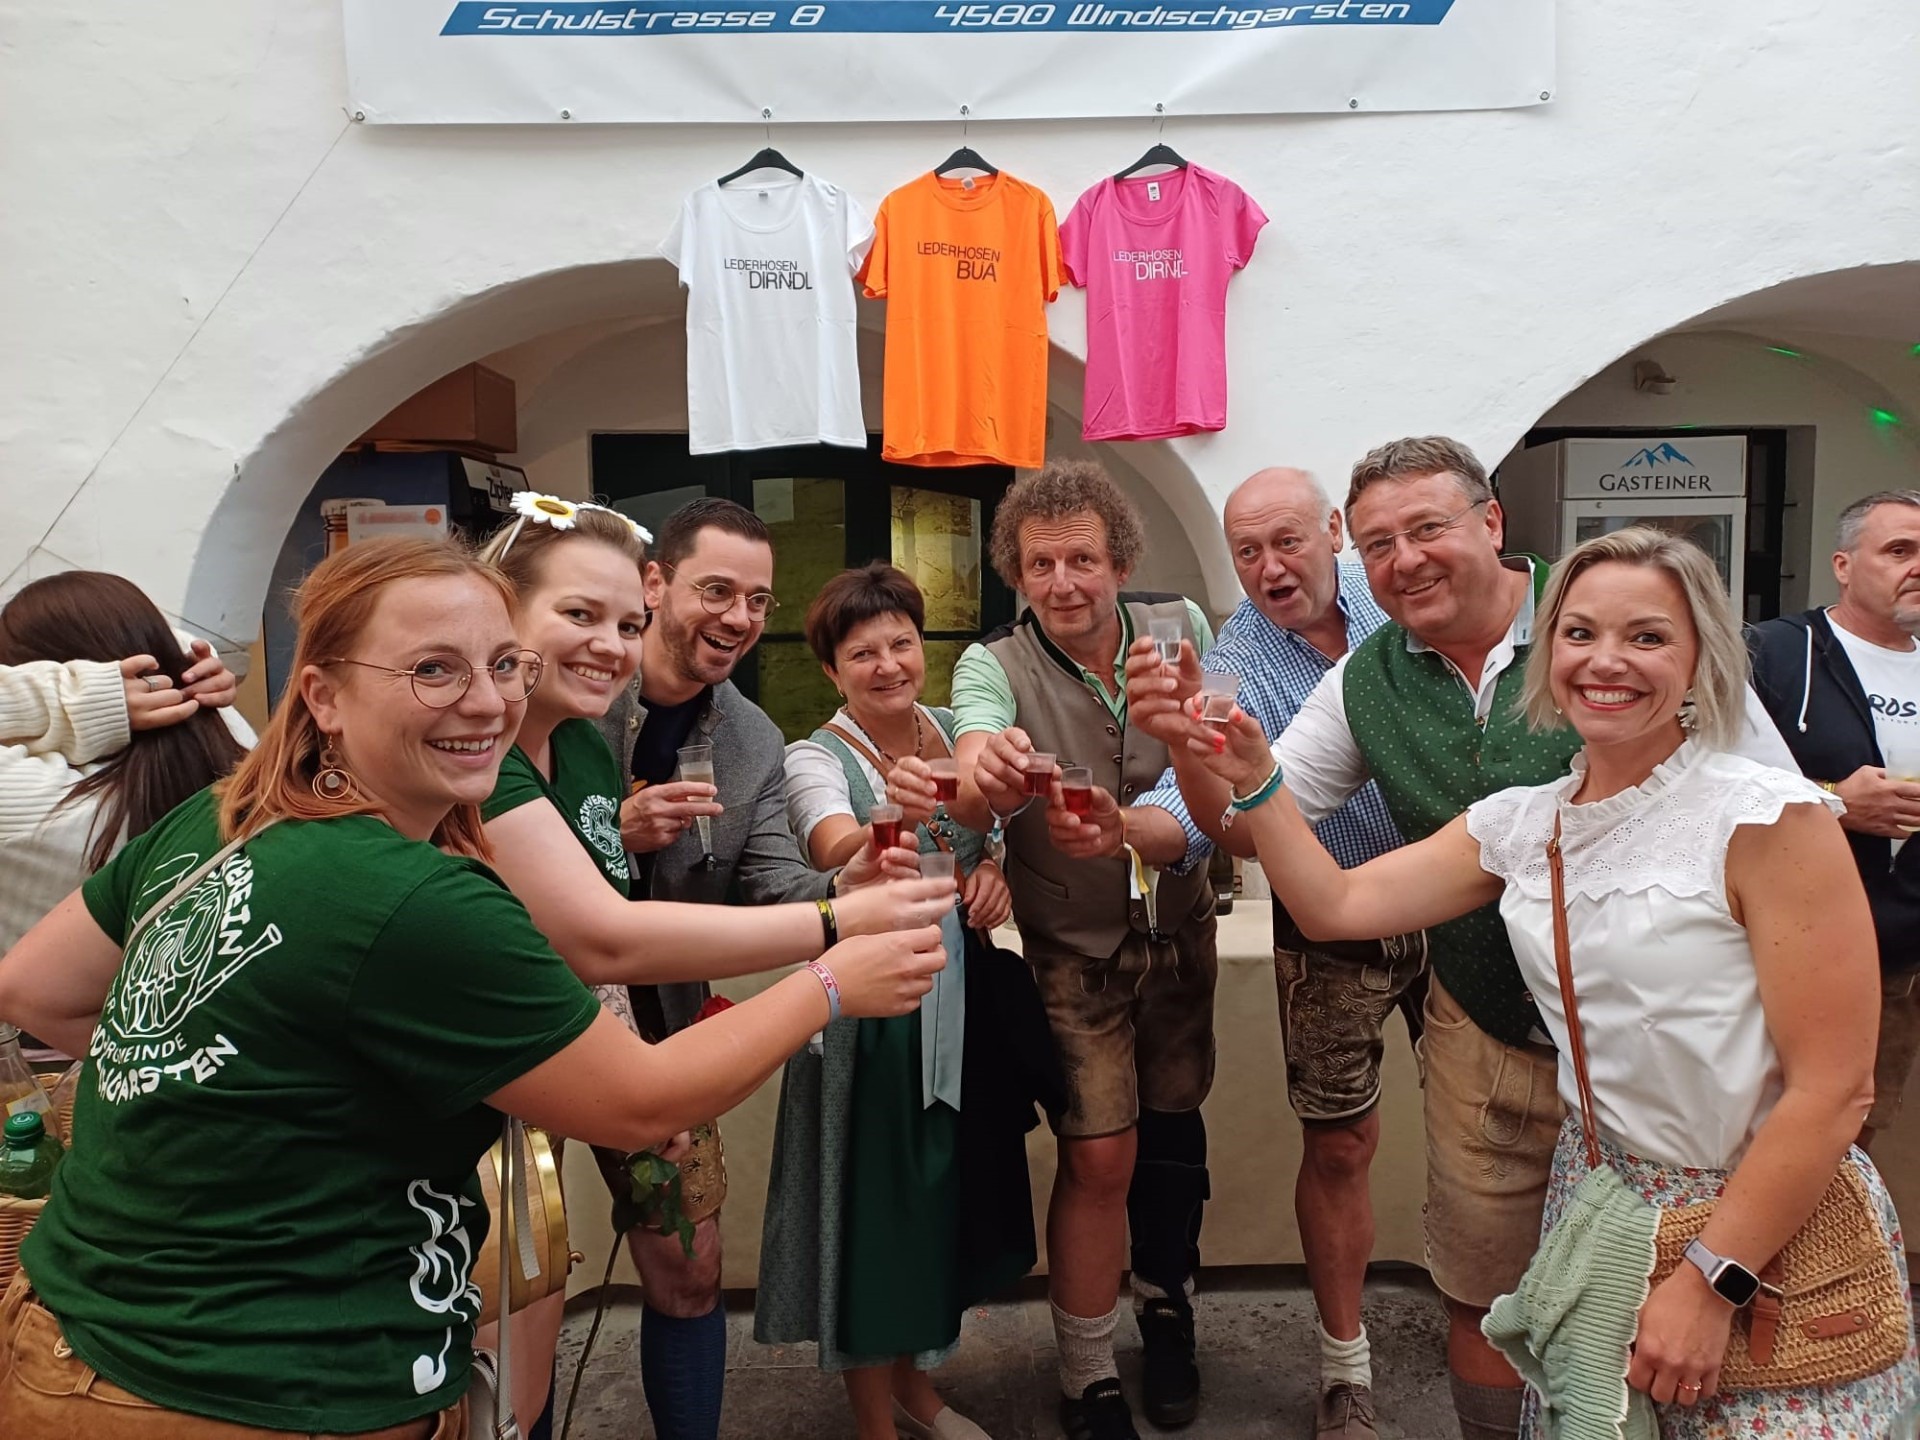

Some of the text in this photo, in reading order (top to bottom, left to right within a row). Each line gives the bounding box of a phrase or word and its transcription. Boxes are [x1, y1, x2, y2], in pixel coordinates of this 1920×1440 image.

[478, 0, 1411, 31] Schulstrasse 8 4580 Windischgarsten
[917, 241, 1001, 263] LEDERHOSEN
[1113, 249, 1182, 262] LEDERHOSEN
[724, 258, 798, 271] LEDERHOSEN
[956, 259, 997, 283] BUA
[749, 270, 813, 290] DIRNDL
[1599, 474, 1712, 492] GASTEINER
